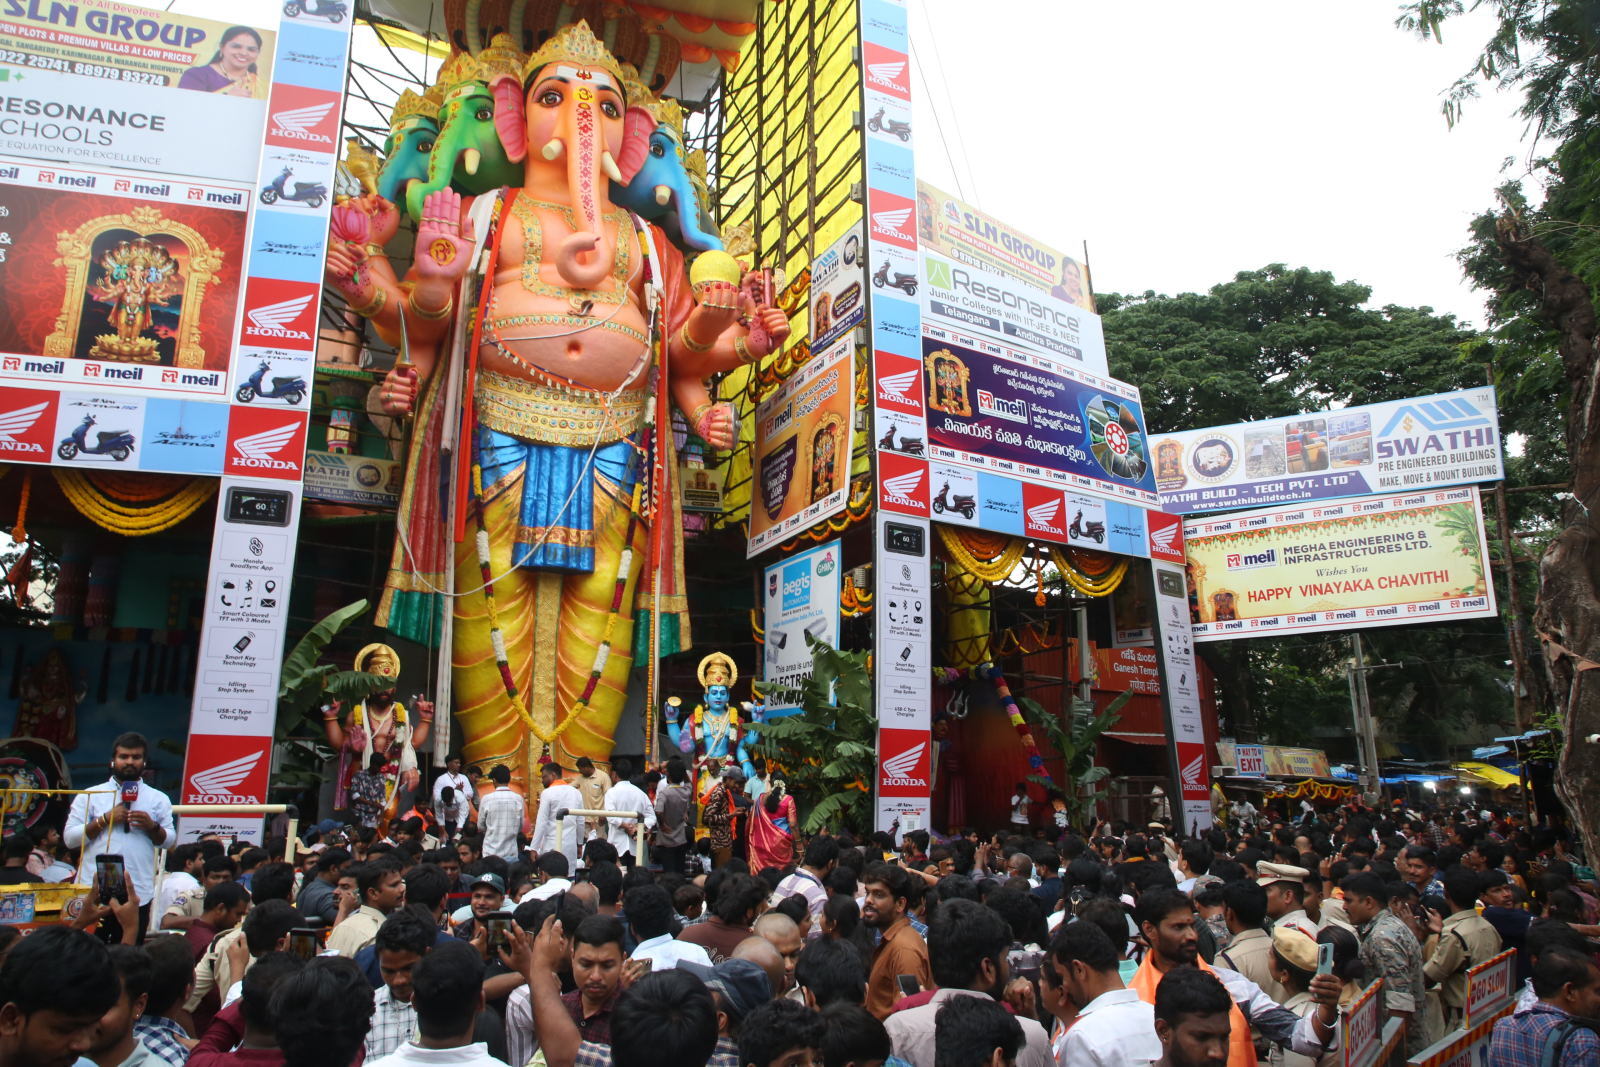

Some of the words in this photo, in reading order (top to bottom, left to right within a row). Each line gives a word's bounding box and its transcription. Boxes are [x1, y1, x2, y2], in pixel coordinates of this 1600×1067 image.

[4, 0, 78, 28] SLN
[85, 10, 206, 48] GROUP
[18, 26, 47, 40] PLOTS
[49, 33, 55, 41] &
[58, 34, 98, 49] PREMIUM
[100, 40, 130, 54] VILLAS
[143, 49, 160, 59] LOW
[162, 52, 193, 63] PRICES
[74, 62, 119, 79] 88979
[121, 71, 164, 86] 93274
[868, 75, 909, 94] HONDA
[271, 128, 333, 144] HONDA
[7, 140, 64, 154] EQUATION
[67, 147, 90, 158] FOR
[93, 151, 162, 166] EXCELLENCE
[58, 175, 97, 188] meil
[133, 184, 170, 197] meil
[206, 192, 243, 206] meil
[872, 225, 915, 243] HONDA
[964, 212, 998, 244] SLN
[1000, 232, 1056, 270] GROUP
[952, 268, 1080, 334] Resonance
[929, 287, 960, 304] Junior
[962, 296, 1002, 317] Colleges
[1003, 309, 1021, 323] with
[1060, 331, 1080, 345] NEET
[942, 304, 990, 327] Telangana
[246, 326, 311, 340] HONDA
[930, 328, 946, 339] meil
[959, 336, 974, 347] meil
[987, 343, 1001, 354] meil
[1015, 328, 1045, 344] Andhra
[1046, 338, 1077, 358] Pradesh
[24, 360, 65, 375] meil
[104, 366, 144, 381] meil
[181, 373, 219, 387] meil
[879, 392, 921, 408] HONDA
[996, 398, 1026, 418] meil
[774, 402, 792, 429] meil
[944, 417, 993, 440] వినాయక
[995, 428, 1022, 446] చవితి
[1025, 435, 1086, 463] శుభాకాంక్షలు
[1376, 427, 1495, 459] SWATHI
[940, 449, 955, 459] meil
[969, 456, 985, 465] meil
[1378, 461, 1394, 472] PRE
[1396, 454, 1448, 470] ENGINEERED
[1450, 448, 1496, 463] BUILDINGS
[232, 457, 299, 471] HONDA
[998, 461, 1013, 470] meil
[1026, 467, 1040, 476] meil
[1053, 472, 1067, 481] meil
[1380, 475, 1402, 488] MAKE,
[1403, 473, 1424, 484] MOVE
[1426, 472, 1432, 482] &
[1433, 468, 1460, 481] MOUNT
[1462, 464, 1497, 478] BUILDING
[1078, 478, 1091, 486] meil
[1202, 488, 1237, 499] BUILD
[1254, 484, 1284, 495] TECH
[1289, 479, 1319, 490] PVT.
[1324, 476, 1349, 486] LTD
[883, 494, 927, 509] HONDA
[1192, 491, 1312, 510] www.swathibuildtech.in
[1404, 495, 1426, 505] meil
[1447, 490, 1469, 499] meil
[255, 503, 266, 511] 60
[1323, 507, 1343, 516] meil
[1363, 501, 1384, 511] meil
[1249, 517, 1267, 526] meil
[1285, 512, 1304, 521] meil
[1028, 523, 1065, 536] HONDA
[1214, 522, 1232, 532] meil
[1283, 543, 1327, 555] MEGHA
[1329, 531, 1415, 549] ENGINEERING
[1418, 530, 1427, 539] &
[1152, 545, 1182, 557] HONDA
[1244, 549, 1276, 566] meil
[1284, 542, 1402, 565] INFRASTRUCTURES
[1405, 540, 1432, 551] LTD.
[1316, 568, 1348, 577] Wishes
[1351, 565, 1368, 574] You
[783, 572, 810, 596] aegis
[1247, 586, 1293, 603] HAPPY
[1299, 578, 1374, 597] VINAYAKA
[1377, 570, 1450, 590] CHAVITHI
[1418, 602, 1440, 612] meil
[1462, 598, 1485, 608] meil
[1297, 613, 1317, 623] meil
[1336, 610, 1357, 620] meil
[1376, 606, 1398, 616] meil
[1225, 620, 1243, 630] meil
[1260, 617, 1279, 626] meil
[776, 664, 785, 673] This
[786, 664, 797, 672] area
[1113, 662, 1139, 674] Ganesh
[1240, 758, 1262, 772] EXIT
[882, 777, 927, 787] HONDA
[187, 794, 261, 805] HONDA
[1476, 978, 1486, 1001] GO
[1487, 968, 1507, 996] SLOW
